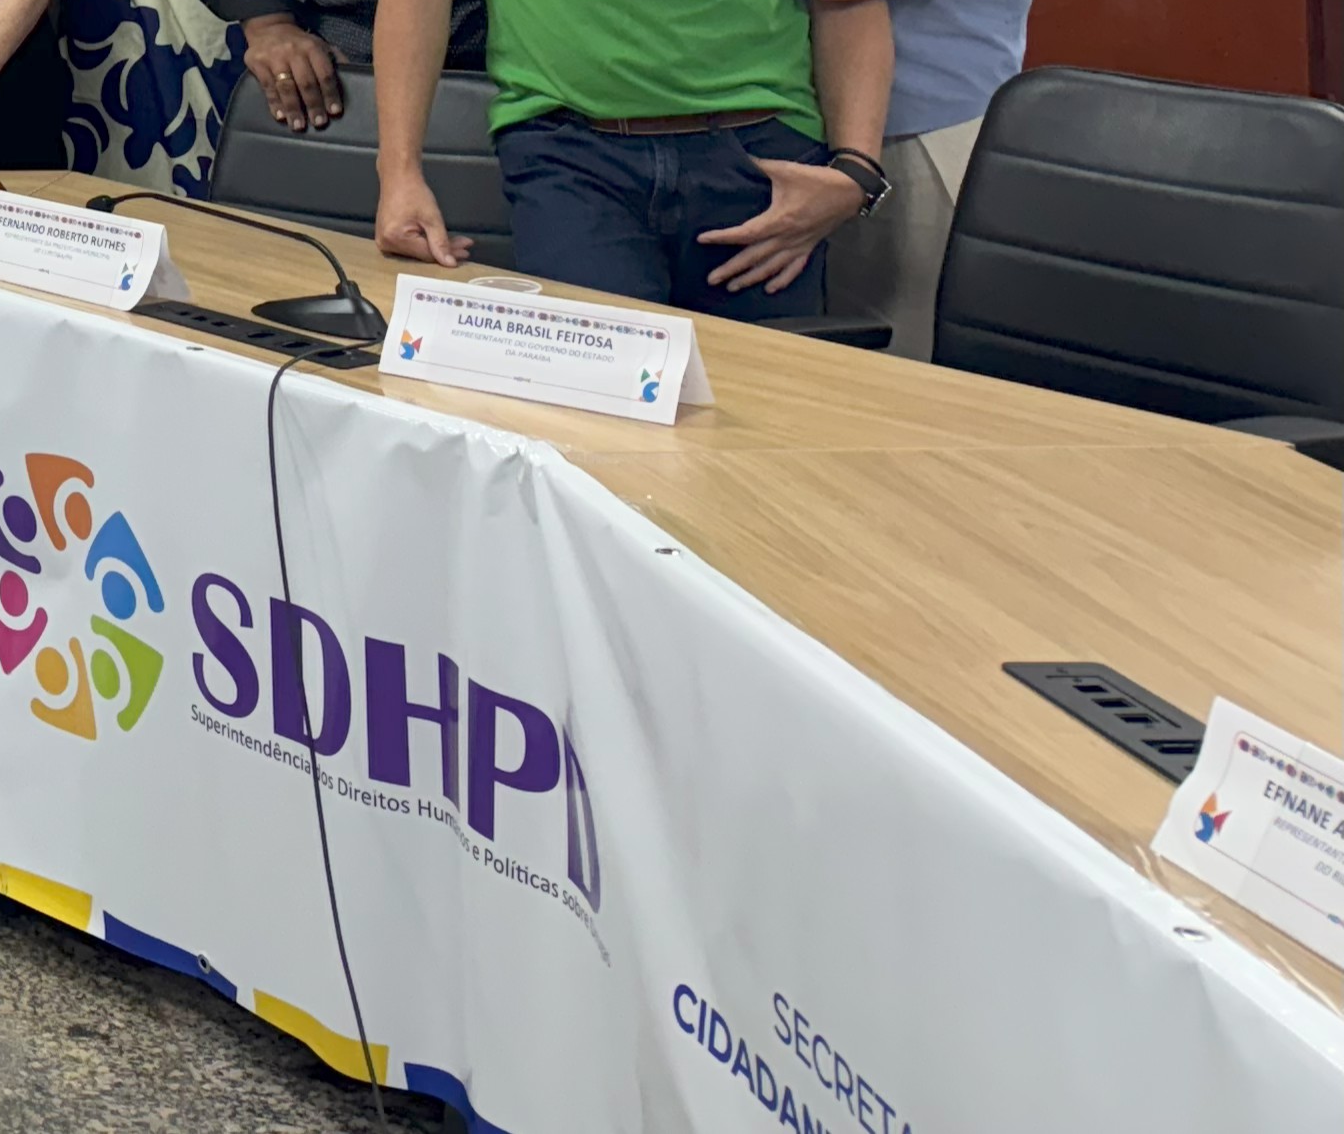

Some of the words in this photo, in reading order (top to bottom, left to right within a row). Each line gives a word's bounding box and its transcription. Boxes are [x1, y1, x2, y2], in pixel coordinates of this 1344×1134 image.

[47, 226, 89, 245] ROBERTO
[90, 236, 127, 253] RUTHES
[457, 313, 503, 332] LAURA
[506, 321, 553, 341] BRASIL
[556, 329, 614, 351] FEITOSA
[191, 704, 313, 776] Superintendência
[315, 762, 334, 790] dos
[337, 778, 411, 816] Direitos
[472, 845, 480, 860] e
[484, 848, 560, 899] Políticas
[562, 888, 590, 929] sobre
[1263, 779, 1333, 830] EFNANE
[673, 984, 832, 1134] CIDADA
[773, 992, 912, 1134] SECRET
